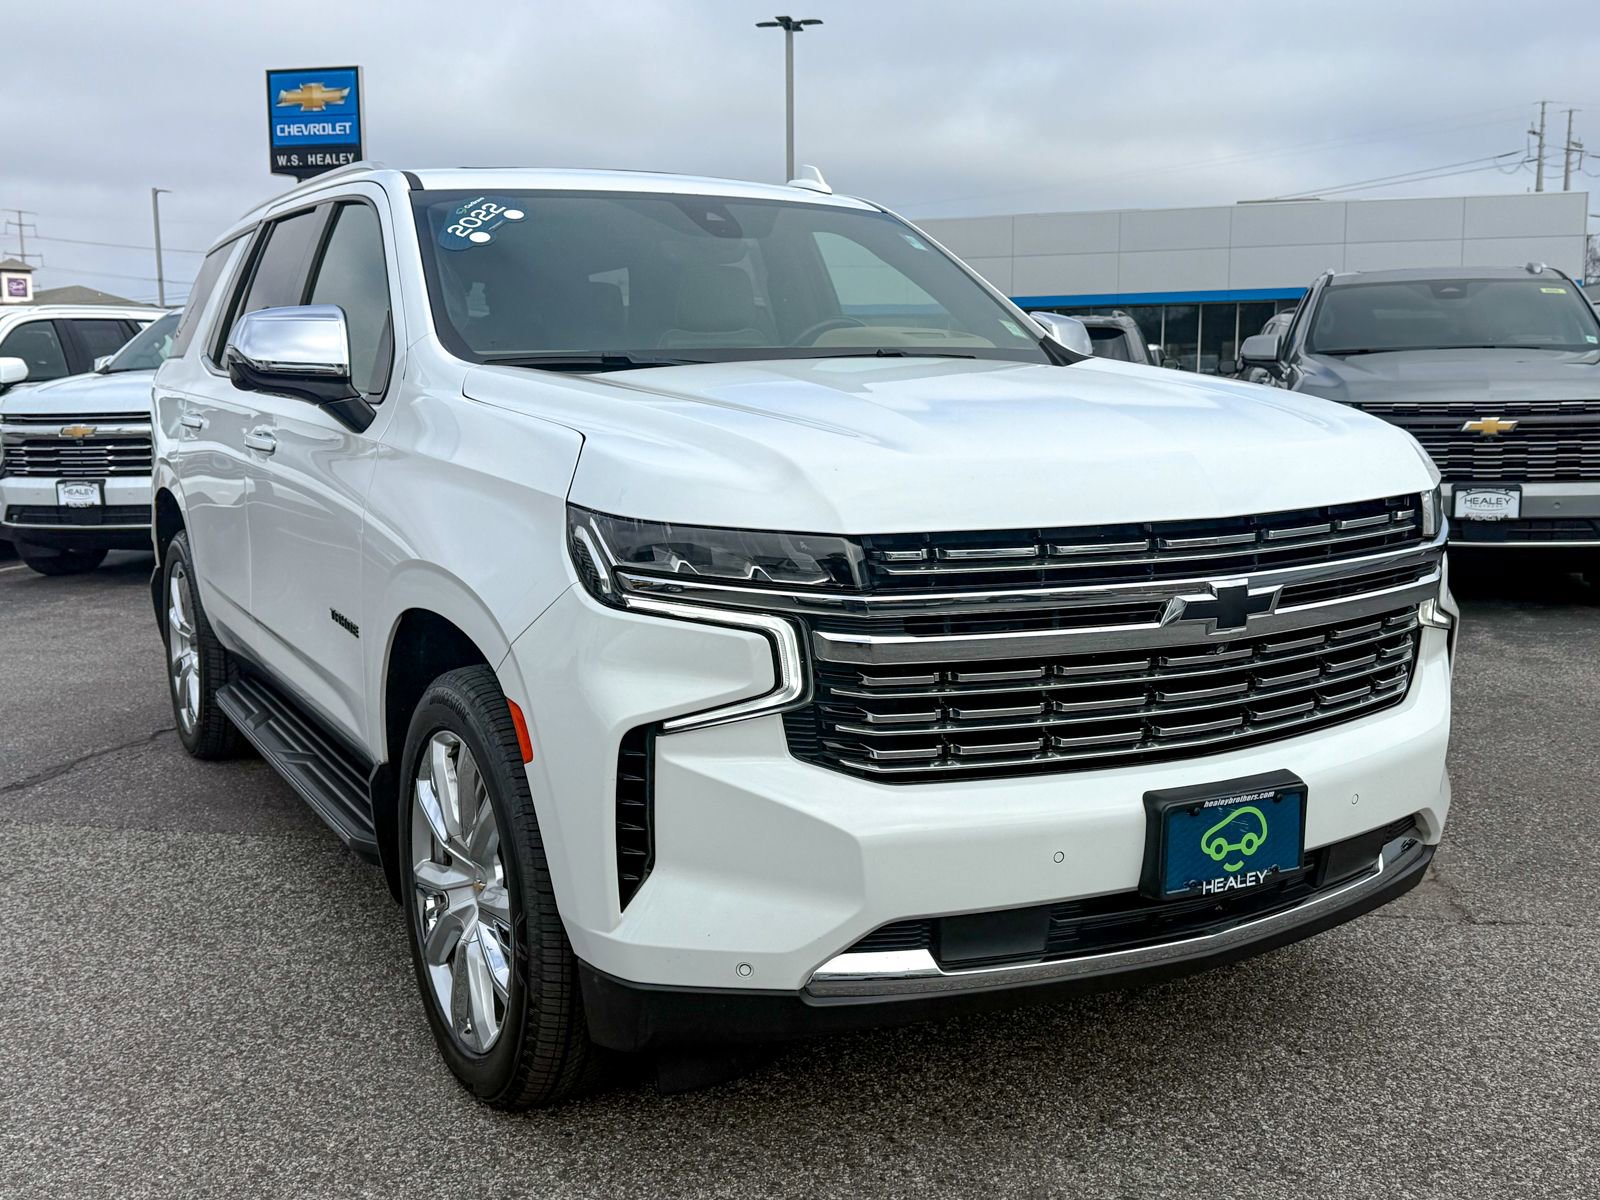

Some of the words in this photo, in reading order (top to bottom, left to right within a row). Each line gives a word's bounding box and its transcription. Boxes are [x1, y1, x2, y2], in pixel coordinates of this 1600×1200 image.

[276, 122, 352, 136] CHEVROLET
[277, 154, 303, 166] W.S.
[307, 152, 355, 166] HEALEY
[447, 203, 507, 238] 2022
[63, 488, 94, 496] HEALEY
[1464, 497, 1511, 505] HEALEY
[1203, 790, 1275, 809] healeybrothers.com
[1202, 869, 1268, 895] HEALEY
